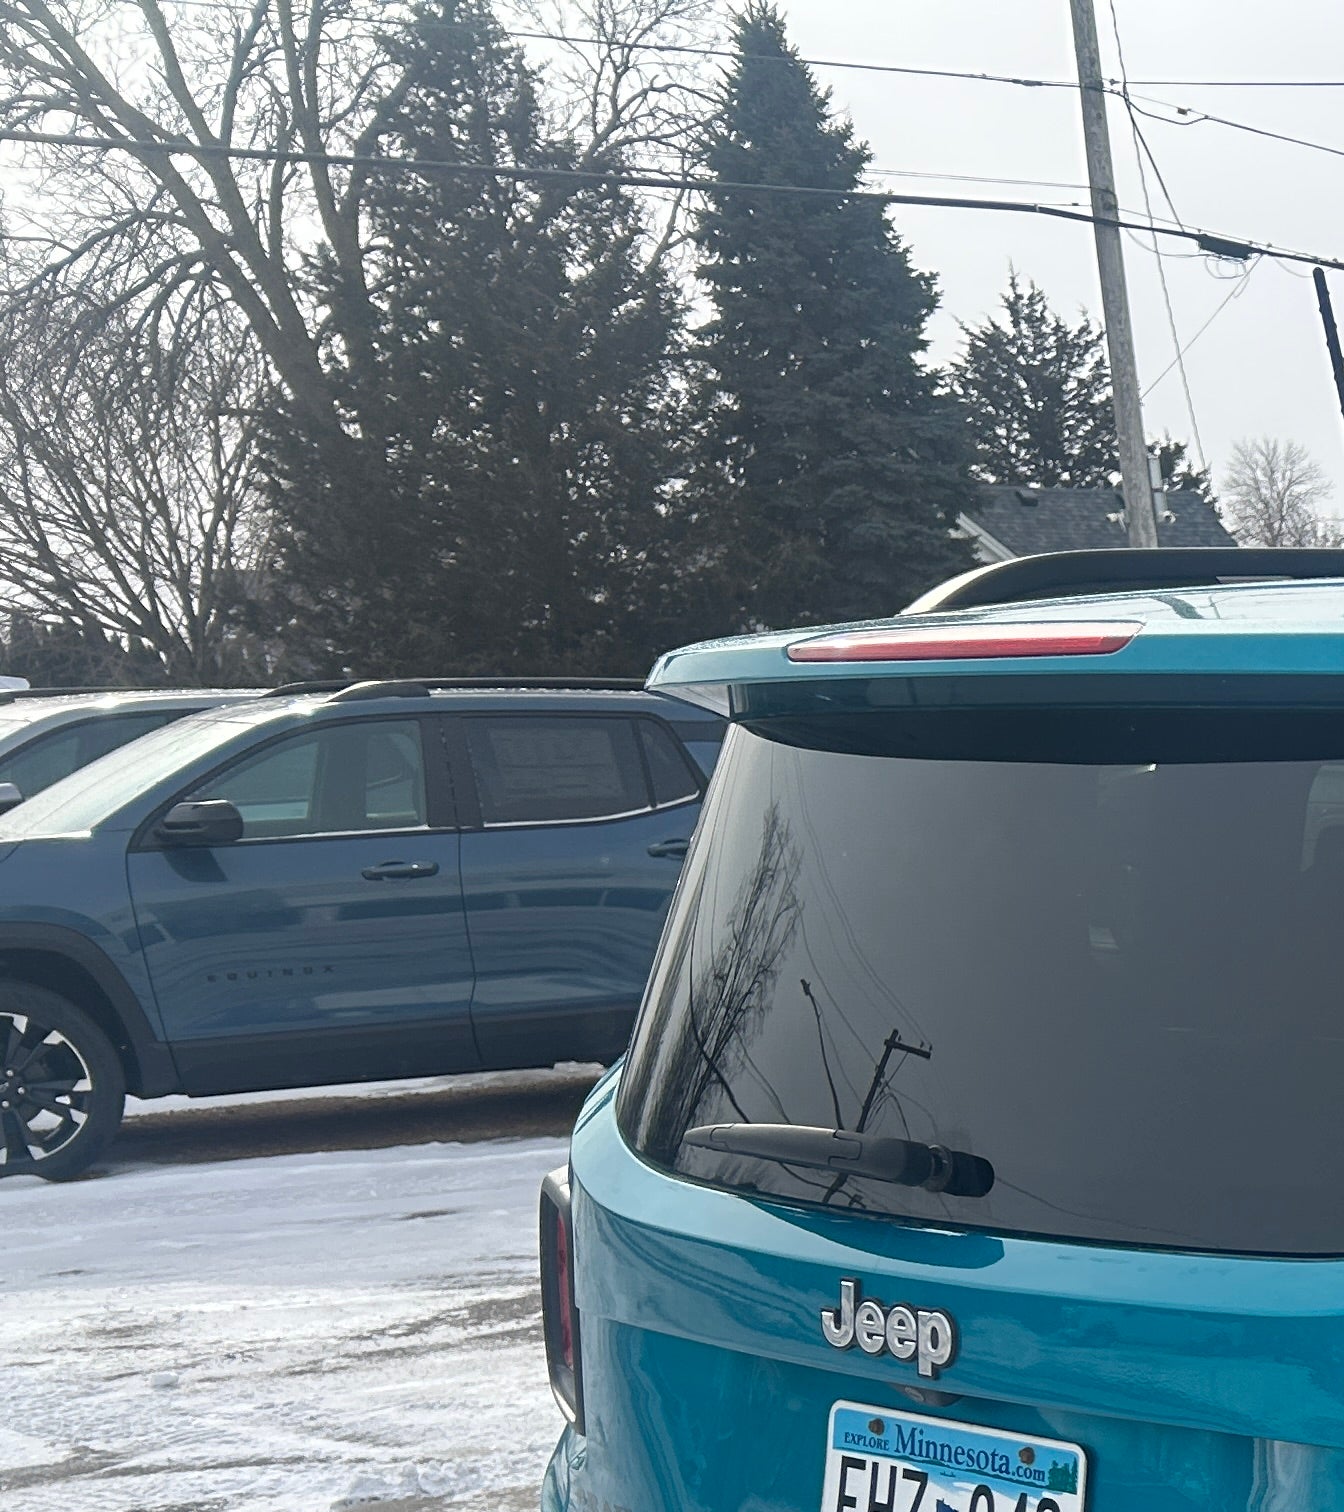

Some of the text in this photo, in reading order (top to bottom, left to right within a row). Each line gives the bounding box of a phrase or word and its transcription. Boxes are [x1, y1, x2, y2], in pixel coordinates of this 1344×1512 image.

[206, 965, 335, 982] EQUINOX
[821, 1279, 955, 1378] Jeep
[844, 1423, 1046, 1482] EXPLORE Minnesota.com
